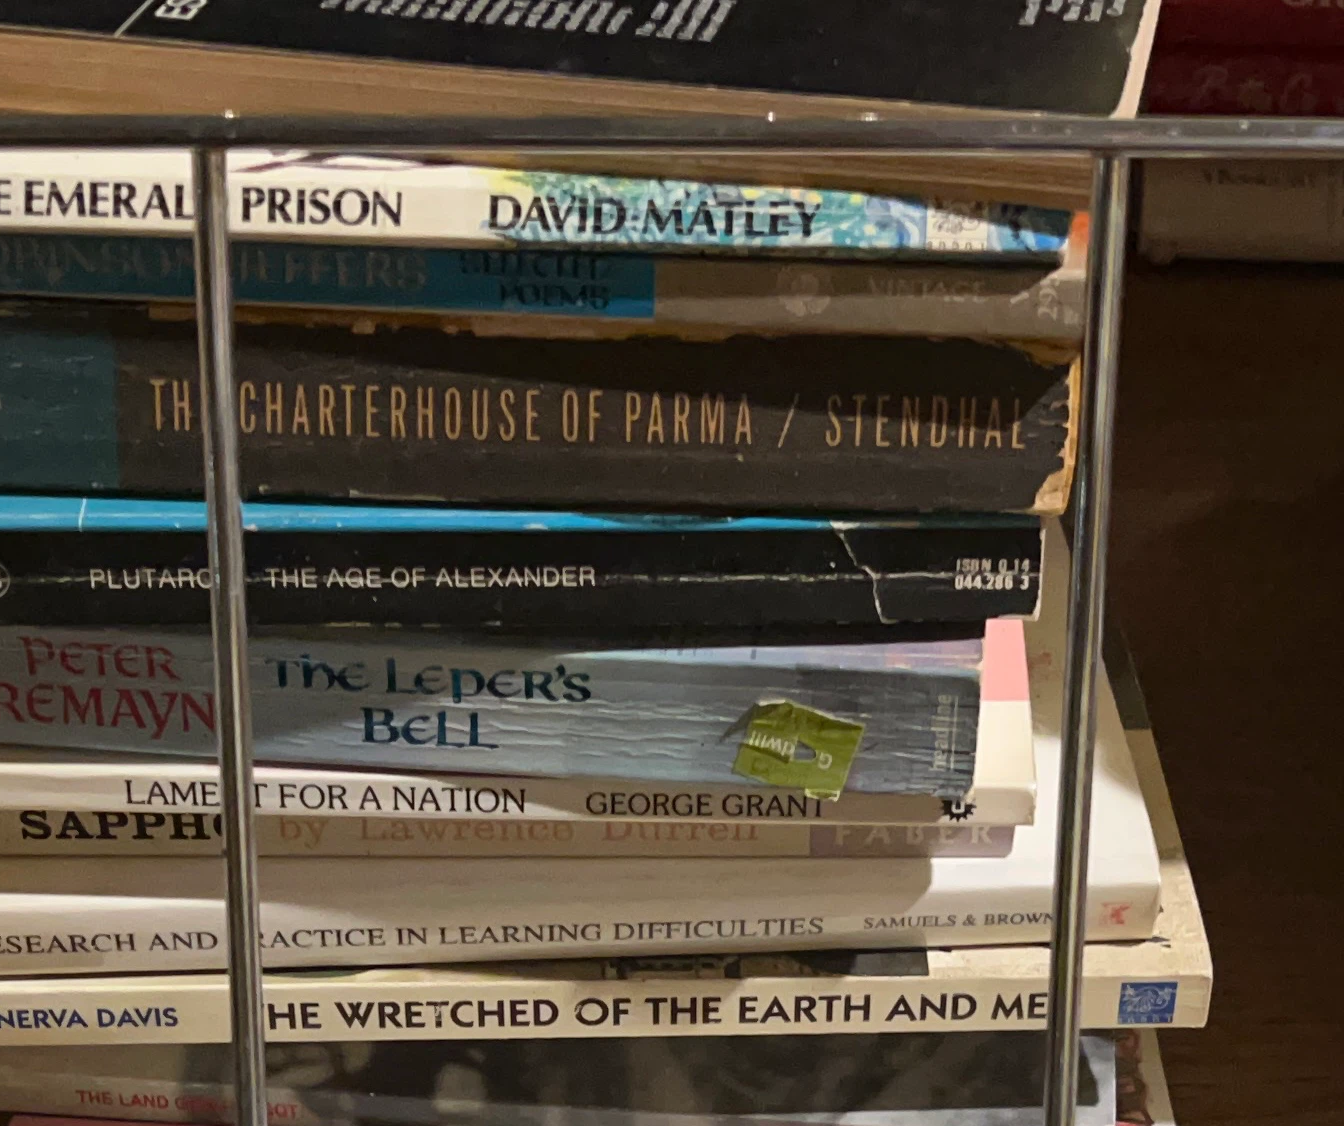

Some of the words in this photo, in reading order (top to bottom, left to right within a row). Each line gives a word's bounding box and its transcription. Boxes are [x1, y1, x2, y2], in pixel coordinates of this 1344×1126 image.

[23, 180, 196, 222] EMERAL
[241, 186, 403, 228] PRISON
[488, 194, 626, 237] DAVID
[642, 196, 822, 239] MATLEY
[150, 377, 195, 432] TH
[241, 380, 542, 442] CHARTERHOUSE
[561, 388, 603, 442] OF
[625, 390, 754, 446] PARMA
[824, 392, 1028, 450] STENDHAL
[89, 566, 216, 591] PLUTARC
[265, 567, 323, 589] THE
[327, 567, 382, 590] AGE
[389, 567, 426, 590] OF
[434, 566, 598, 590] ALEXANDER
[956, 558, 994, 574] ISBN
[17, 636, 183, 683] PETER
[124, 779, 268, 808] LAMET
[278, 782, 348, 812] FOR
[359, 786, 384, 812] A
[392, 787, 527, 814] NATION
[585, 791, 714, 818] GEORGE
[722, 792, 825, 818] GRANT
[279, 813, 326, 847] by
[360, 815, 576, 843] Lawrence
[600, 821, 759, 843] Durrell
[832, 825, 994, 846] FABER
[149, 930, 218, 954] AND
[395, 926, 428, 946] IN
[438, 923, 602, 948] LEARNING
[612, 915, 825, 942] DIFFICULTIES
[863, 913, 957, 930] SAMUELS
[961, 912, 977, 928] &
[97, 1006, 179, 1028] DAVIS
[262, 1001, 323, 1031] HE
[337, 999, 556, 1029] WRETCHED
[574, 997, 633, 1027] OF
[644, 996, 723, 1025] THE
[739, 993, 873, 1025] EARTH
[887, 992, 978, 1022] AND
[75, 1088, 115, 1107] THE
[118, 1090, 169, 1110] LAND
